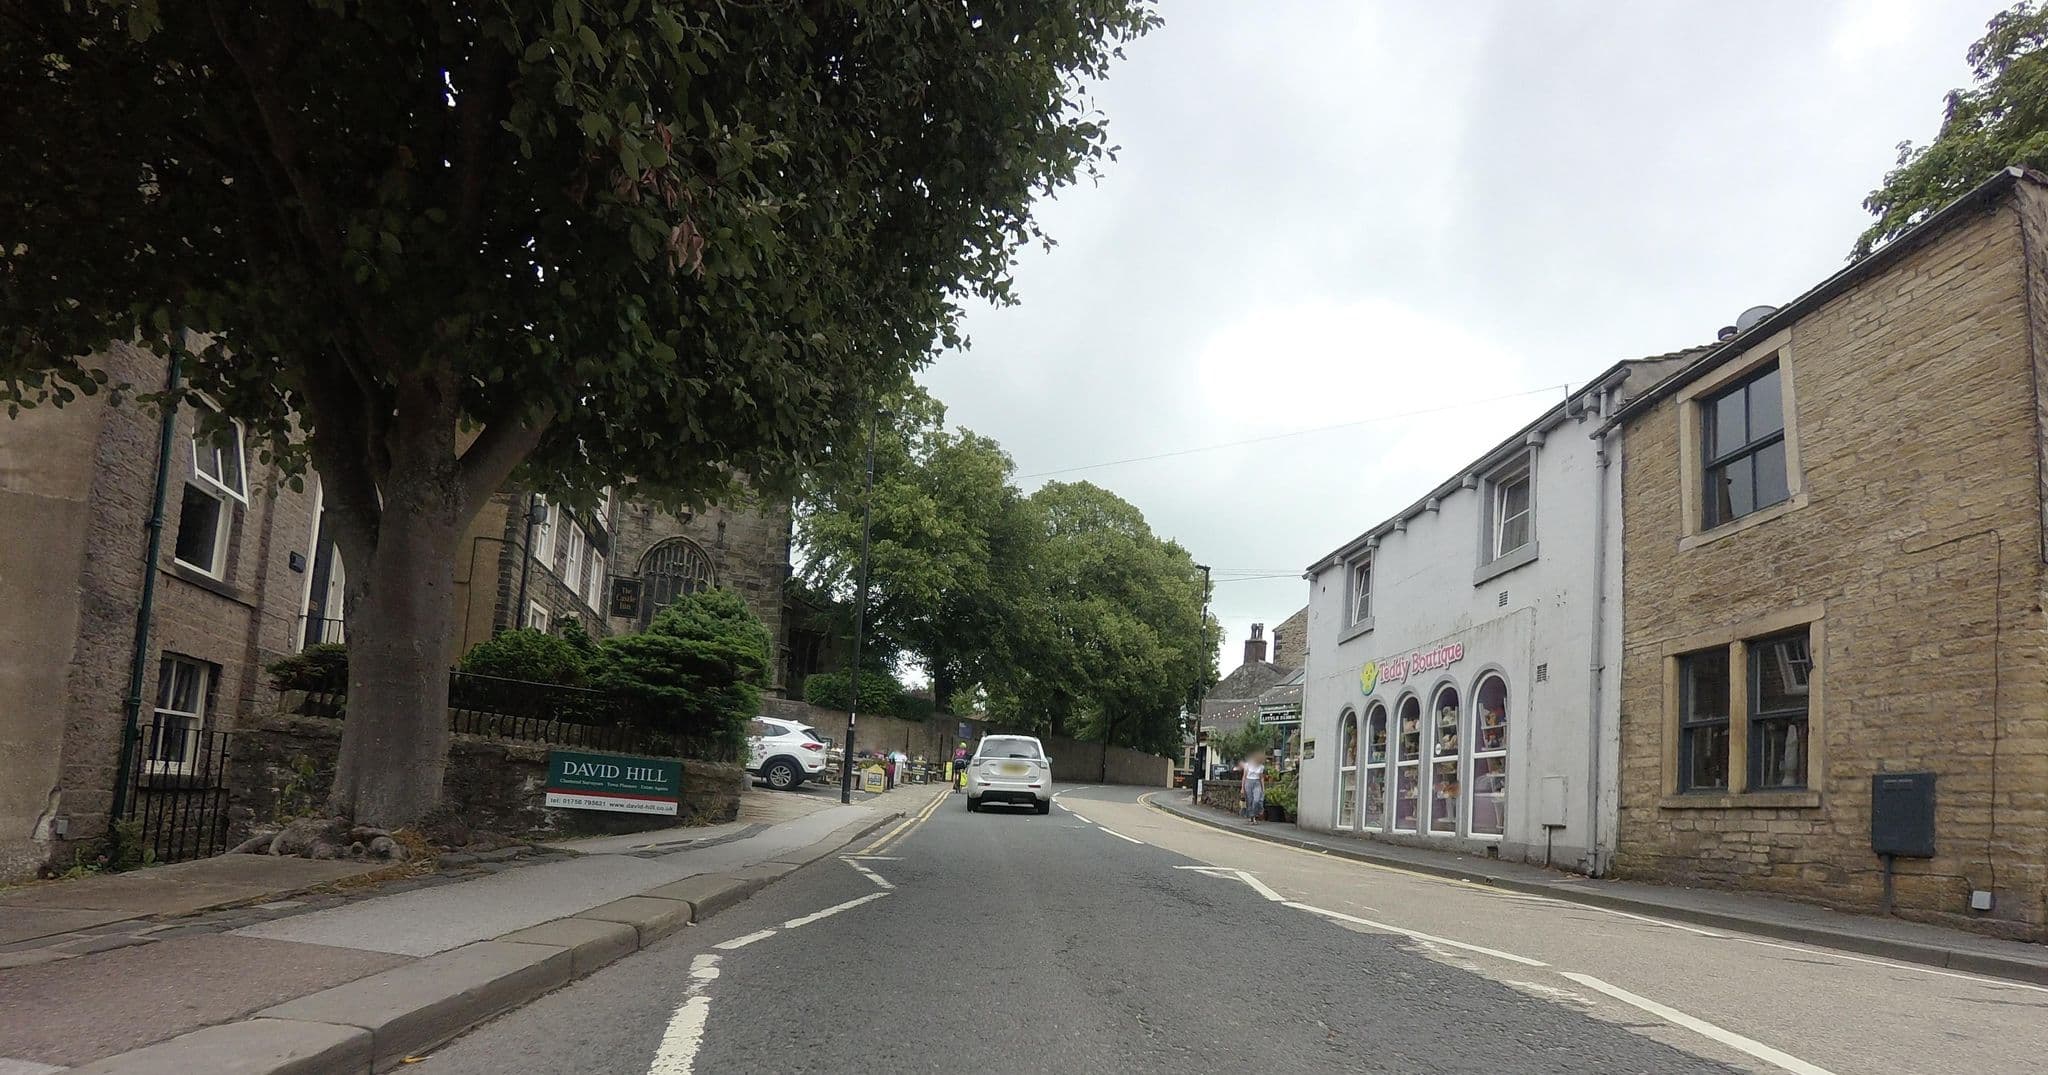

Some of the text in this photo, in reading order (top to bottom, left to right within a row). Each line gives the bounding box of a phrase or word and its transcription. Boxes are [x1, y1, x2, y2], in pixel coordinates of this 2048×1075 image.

[1378, 642, 1464, 684] Teddy Boutique
[563, 761, 667, 783] DAVID HILL
[609, 802, 674, 812] www.david-hill.co.uk
